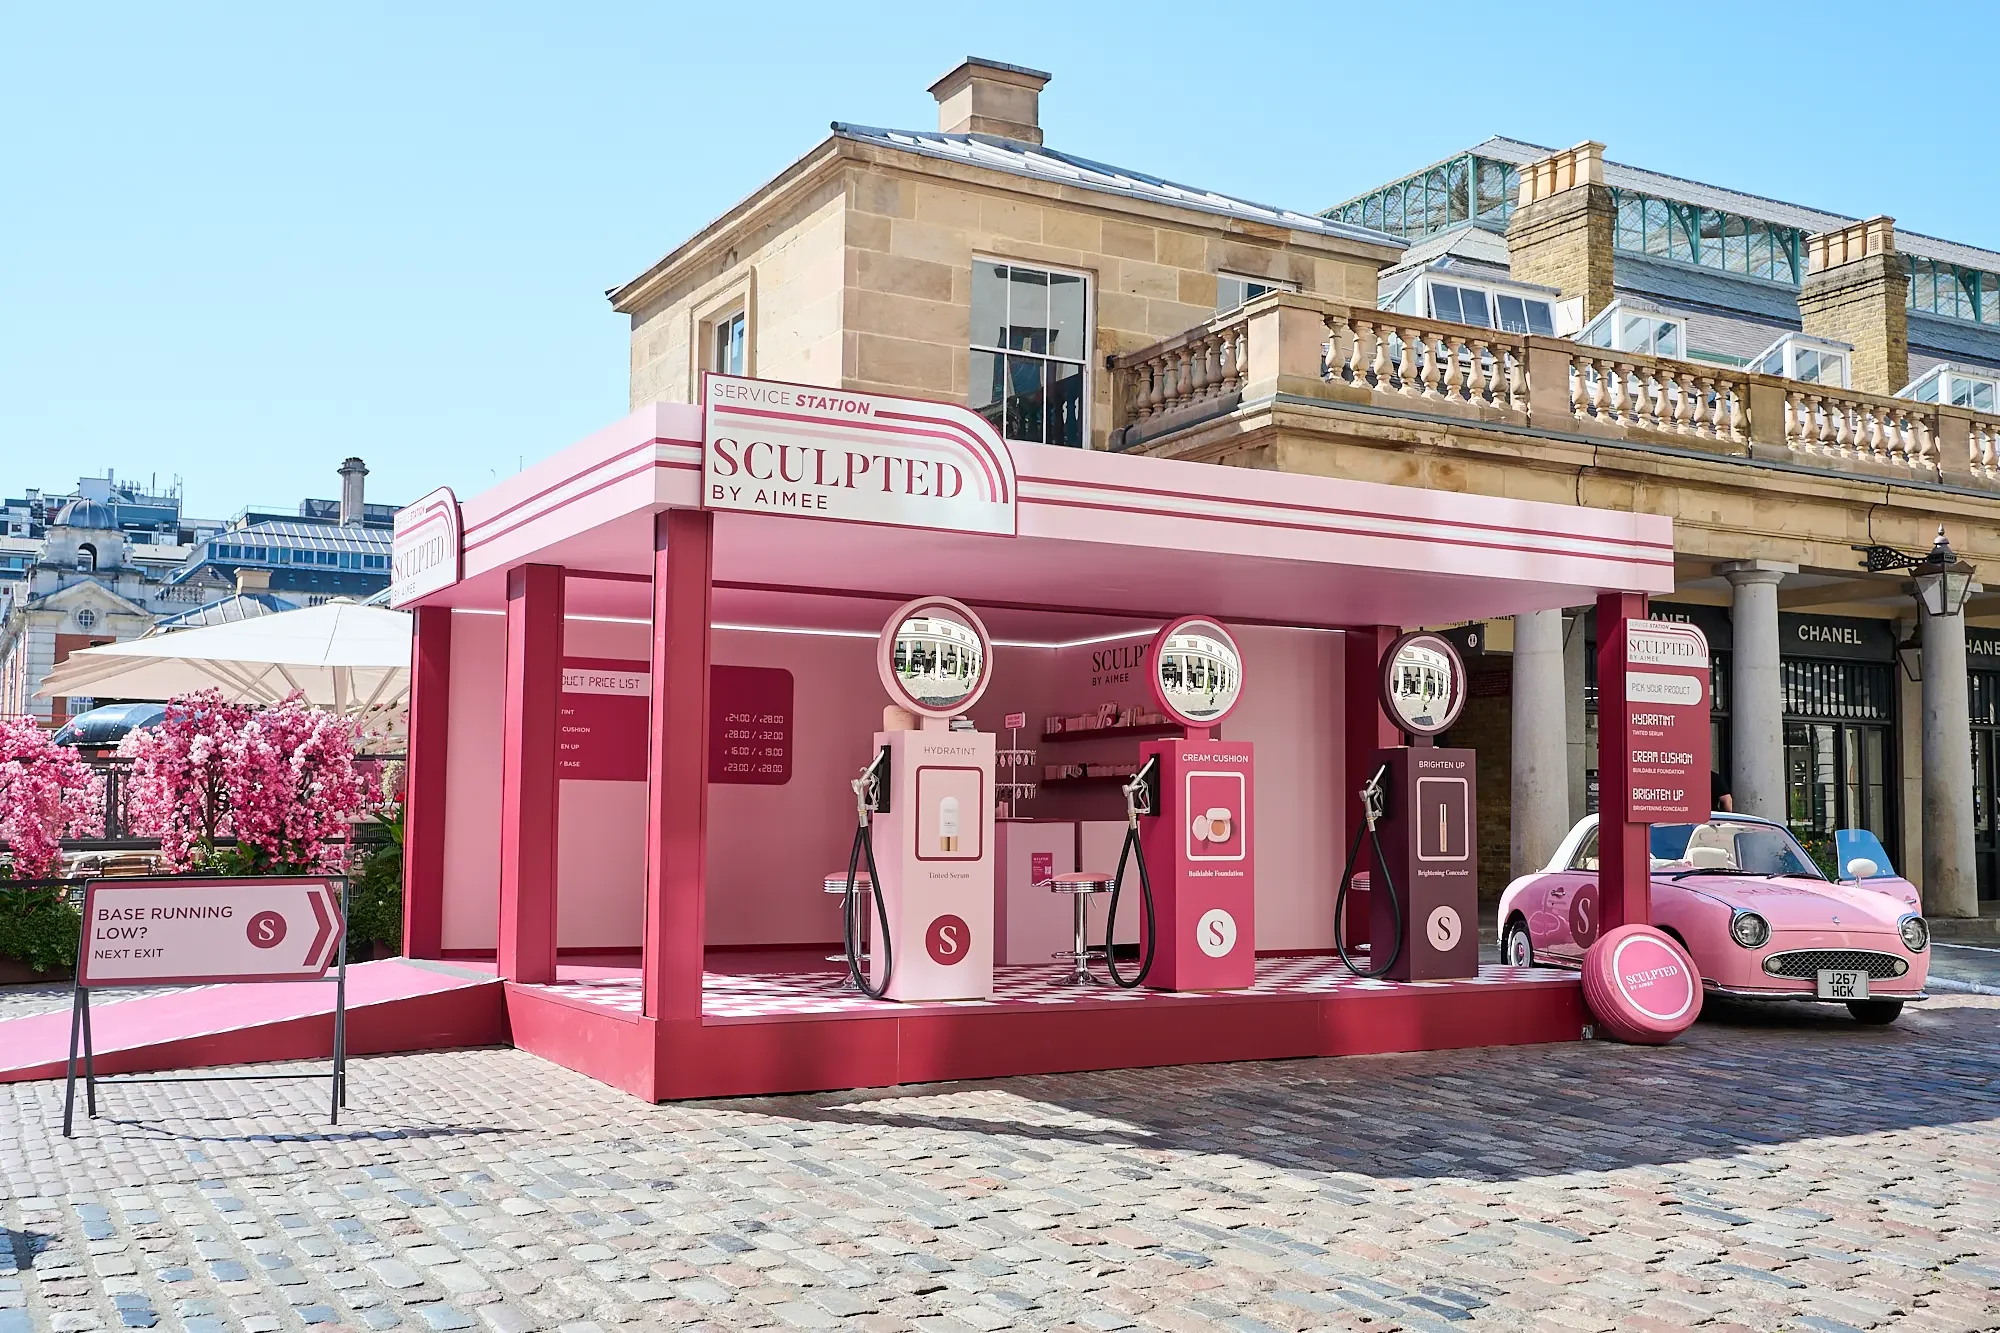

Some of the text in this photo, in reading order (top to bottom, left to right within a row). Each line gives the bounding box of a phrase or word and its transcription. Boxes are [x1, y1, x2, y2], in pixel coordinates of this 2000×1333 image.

[714, 383, 871, 415] SERVICE STATION
[713, 437, 962, 499] SCULPTED
[712, 485, 828, 510] BY AIMEE
[394, 536, 444, 583] SCULPTED
[1798, 625, 1862, 645] CHANEL
[1629, 639, 1694, 657] SCULPTED
[1965, 639, 2000, 656] HANE
[1092, 644, 1151, 673] SCULP
[562, 675, 640, 689] DUCT PRICE LIST
[1092, 673, 1130, 686] BY AIMEE
[1631, 682, 1690, 695] PICK YOUR PRODUCT
[1631, 713, 1675, 726] HYDRATINT
[924, 746, 976, 755] HYDRATINT
[1182, 753, 1249, 763] CREAM CUSHION
[1632, 750, 1693, 765] CREAM CUSHION
[1418, 760, 1466, 769] BRIGHTEN UP
[1632, 788, 1684, 801] BRIGHTEN UP
[1188, 869, 1244, 877] Buildable Foundation
[1417, 869, 1445, 878] Brightening
[98, 906, 233, 921] BASE RUNNING
[1577, 897, 1591, 934] S
[96, 926, 148, 940] LOW?
[258, 919, 275, 941] S
[1209, 920, 1224, 946] S
[1437, 916, 1451, 941] S
[939, 925, 958, 955] S
[94, 948, 164, 959] NEXT EXIT
[1625, 965, 1678, 985] SCULPTED
[1828, 972, 1857, 985] J267
[1639, 980, 1654, 989] AIMEE
[1832, 985, 1855, 997] HGK
